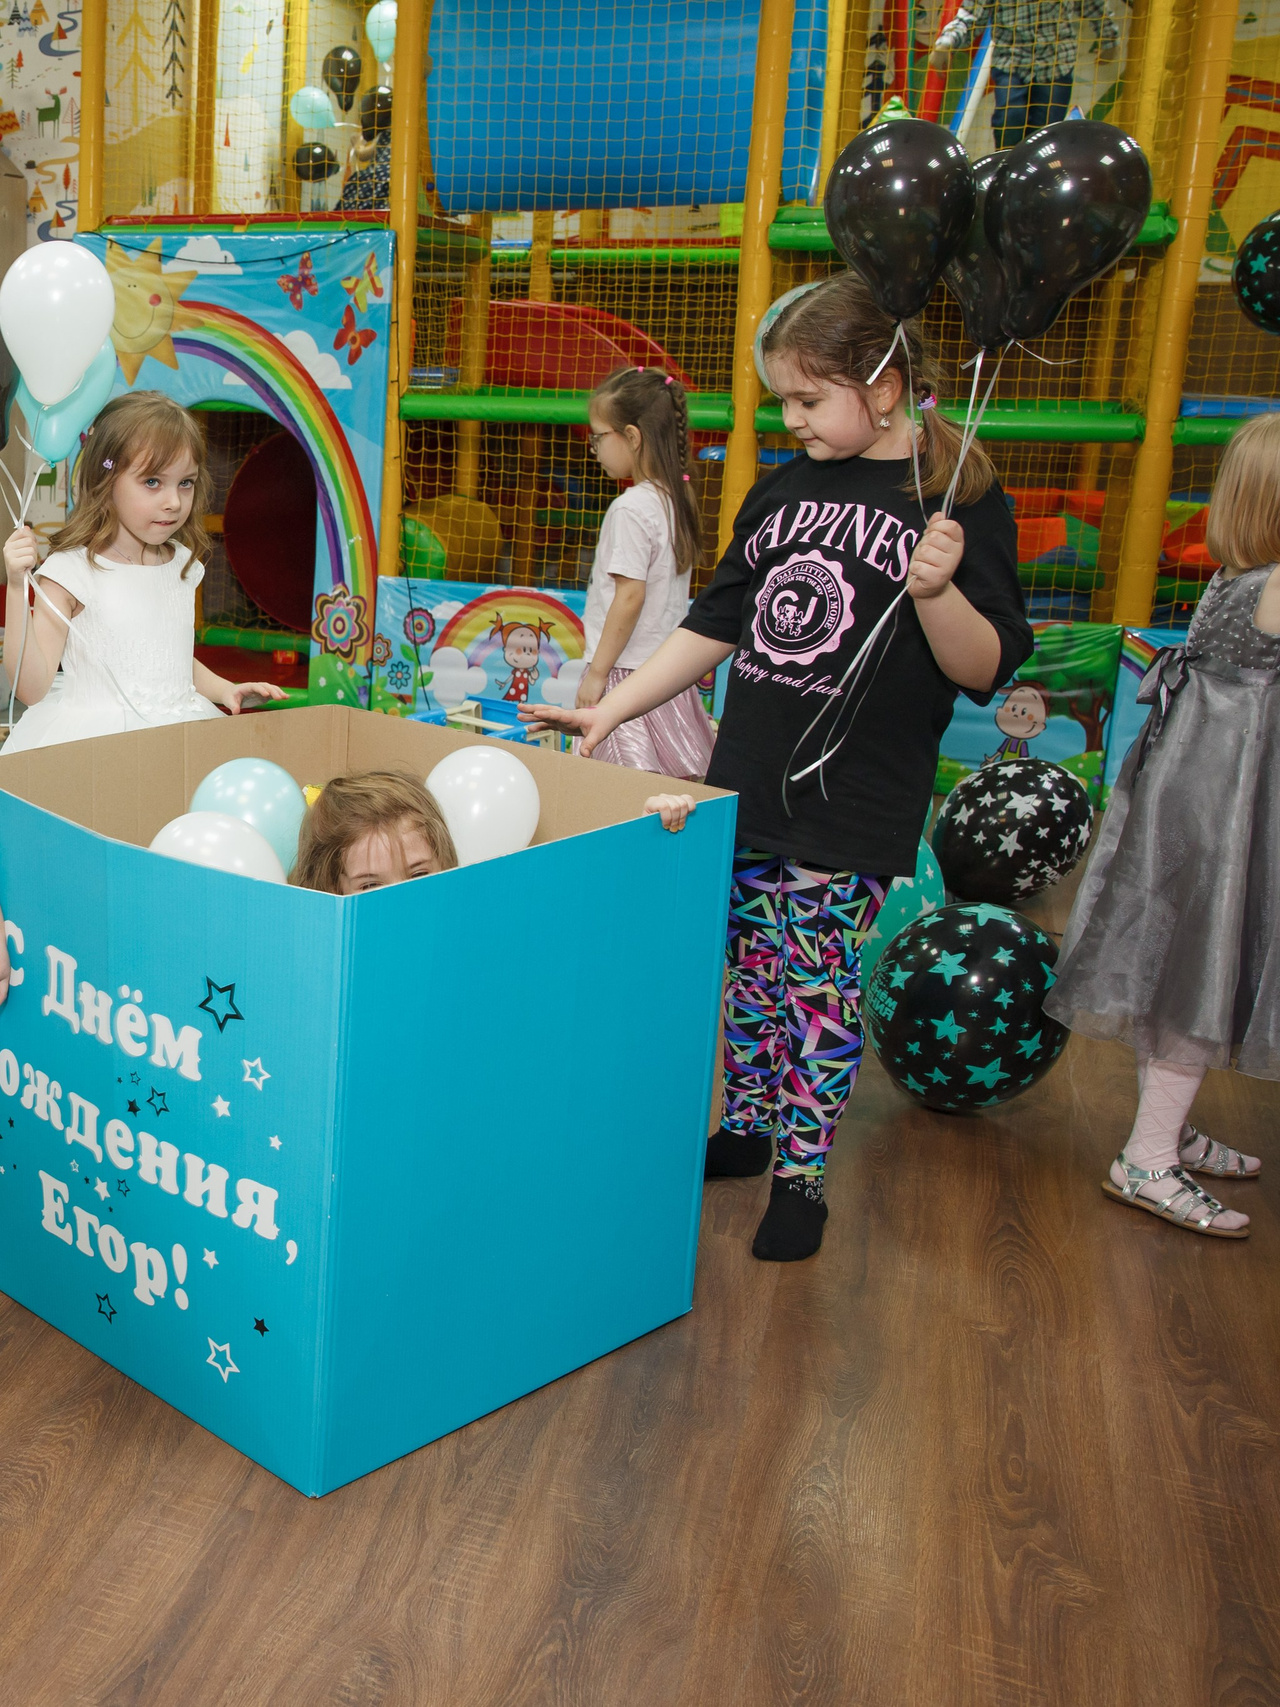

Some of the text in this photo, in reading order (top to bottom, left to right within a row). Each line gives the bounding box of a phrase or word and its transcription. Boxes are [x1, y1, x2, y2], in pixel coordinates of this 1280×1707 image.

[745, 501, 919, 582] HAPPINES
[776, 569, 793, 582] DAY
[783, 576, 795, 585] CAN
[806, 577, 817, 588] THE
[815, 584, 824, 595] SKY
[800, 564, 829, 583] LITTLE
[826, 582, 837, 599] BIT
[824, 601, 838, 630] MORE
[734, 649, 843, 696] Happy and fun
[42, 945, 202, 1081] Днём
[39, 1170, 189, 1310] Егор!
